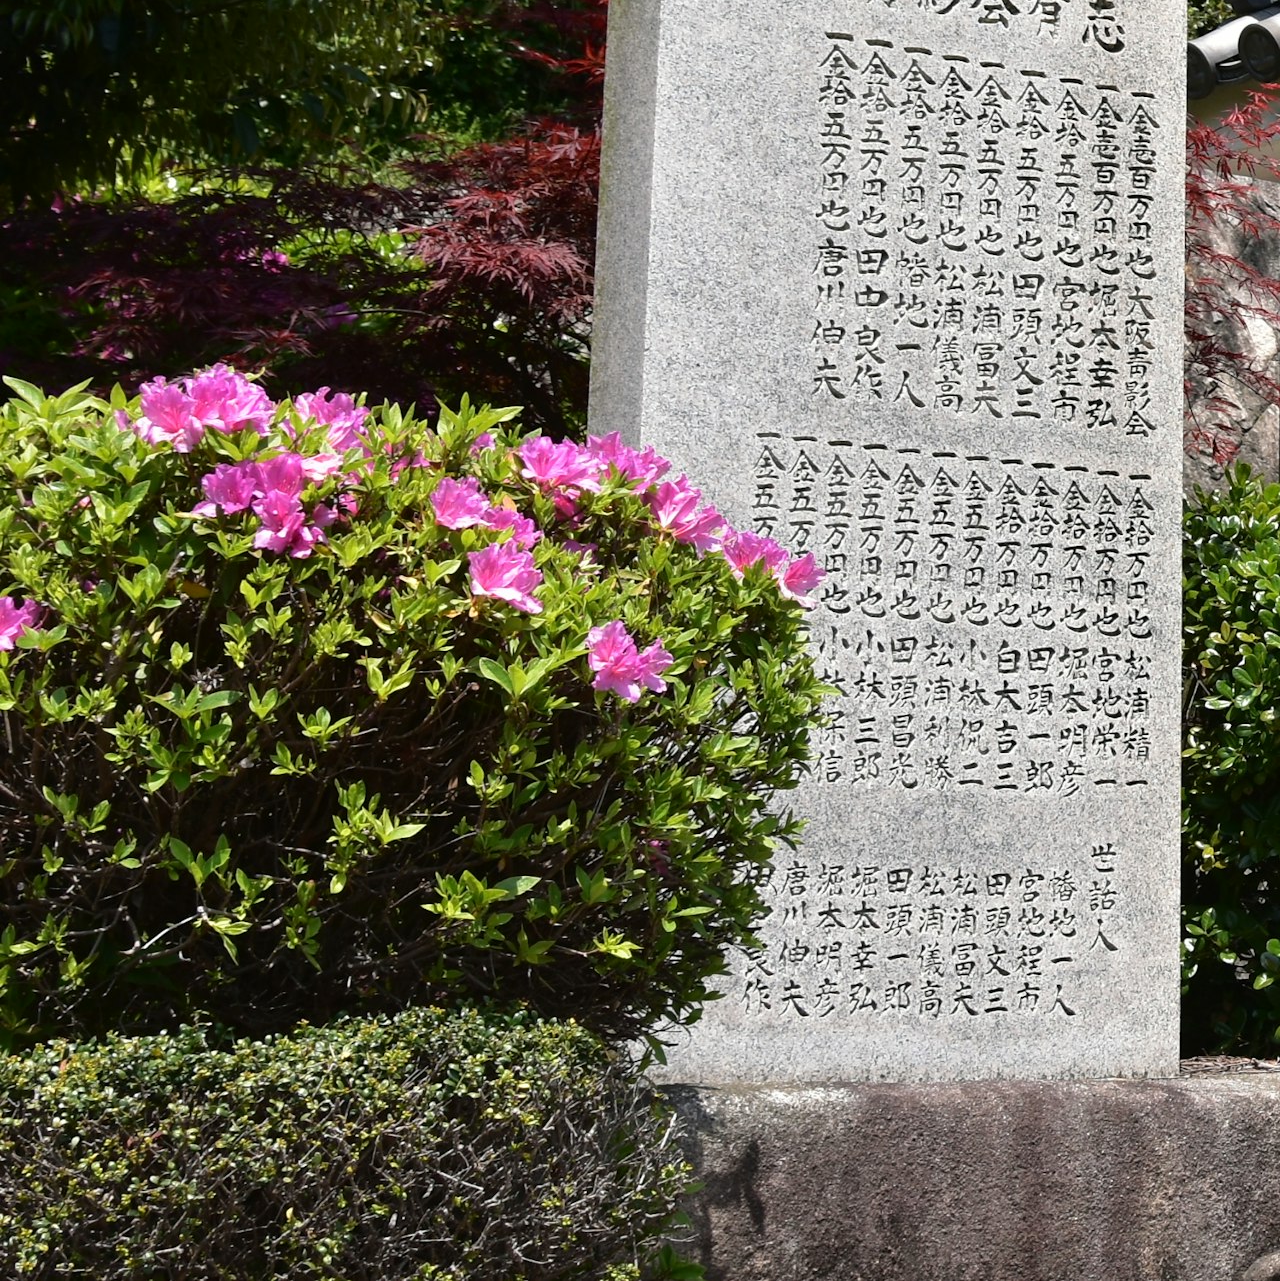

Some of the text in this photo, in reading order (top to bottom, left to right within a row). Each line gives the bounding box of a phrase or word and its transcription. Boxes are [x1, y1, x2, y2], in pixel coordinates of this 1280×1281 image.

[883, 869, 914, 1013] 田頭一郎
[983, 871, 1012, 1015] 田頭文三
[1089, 841, 1119, 953] 世話人
